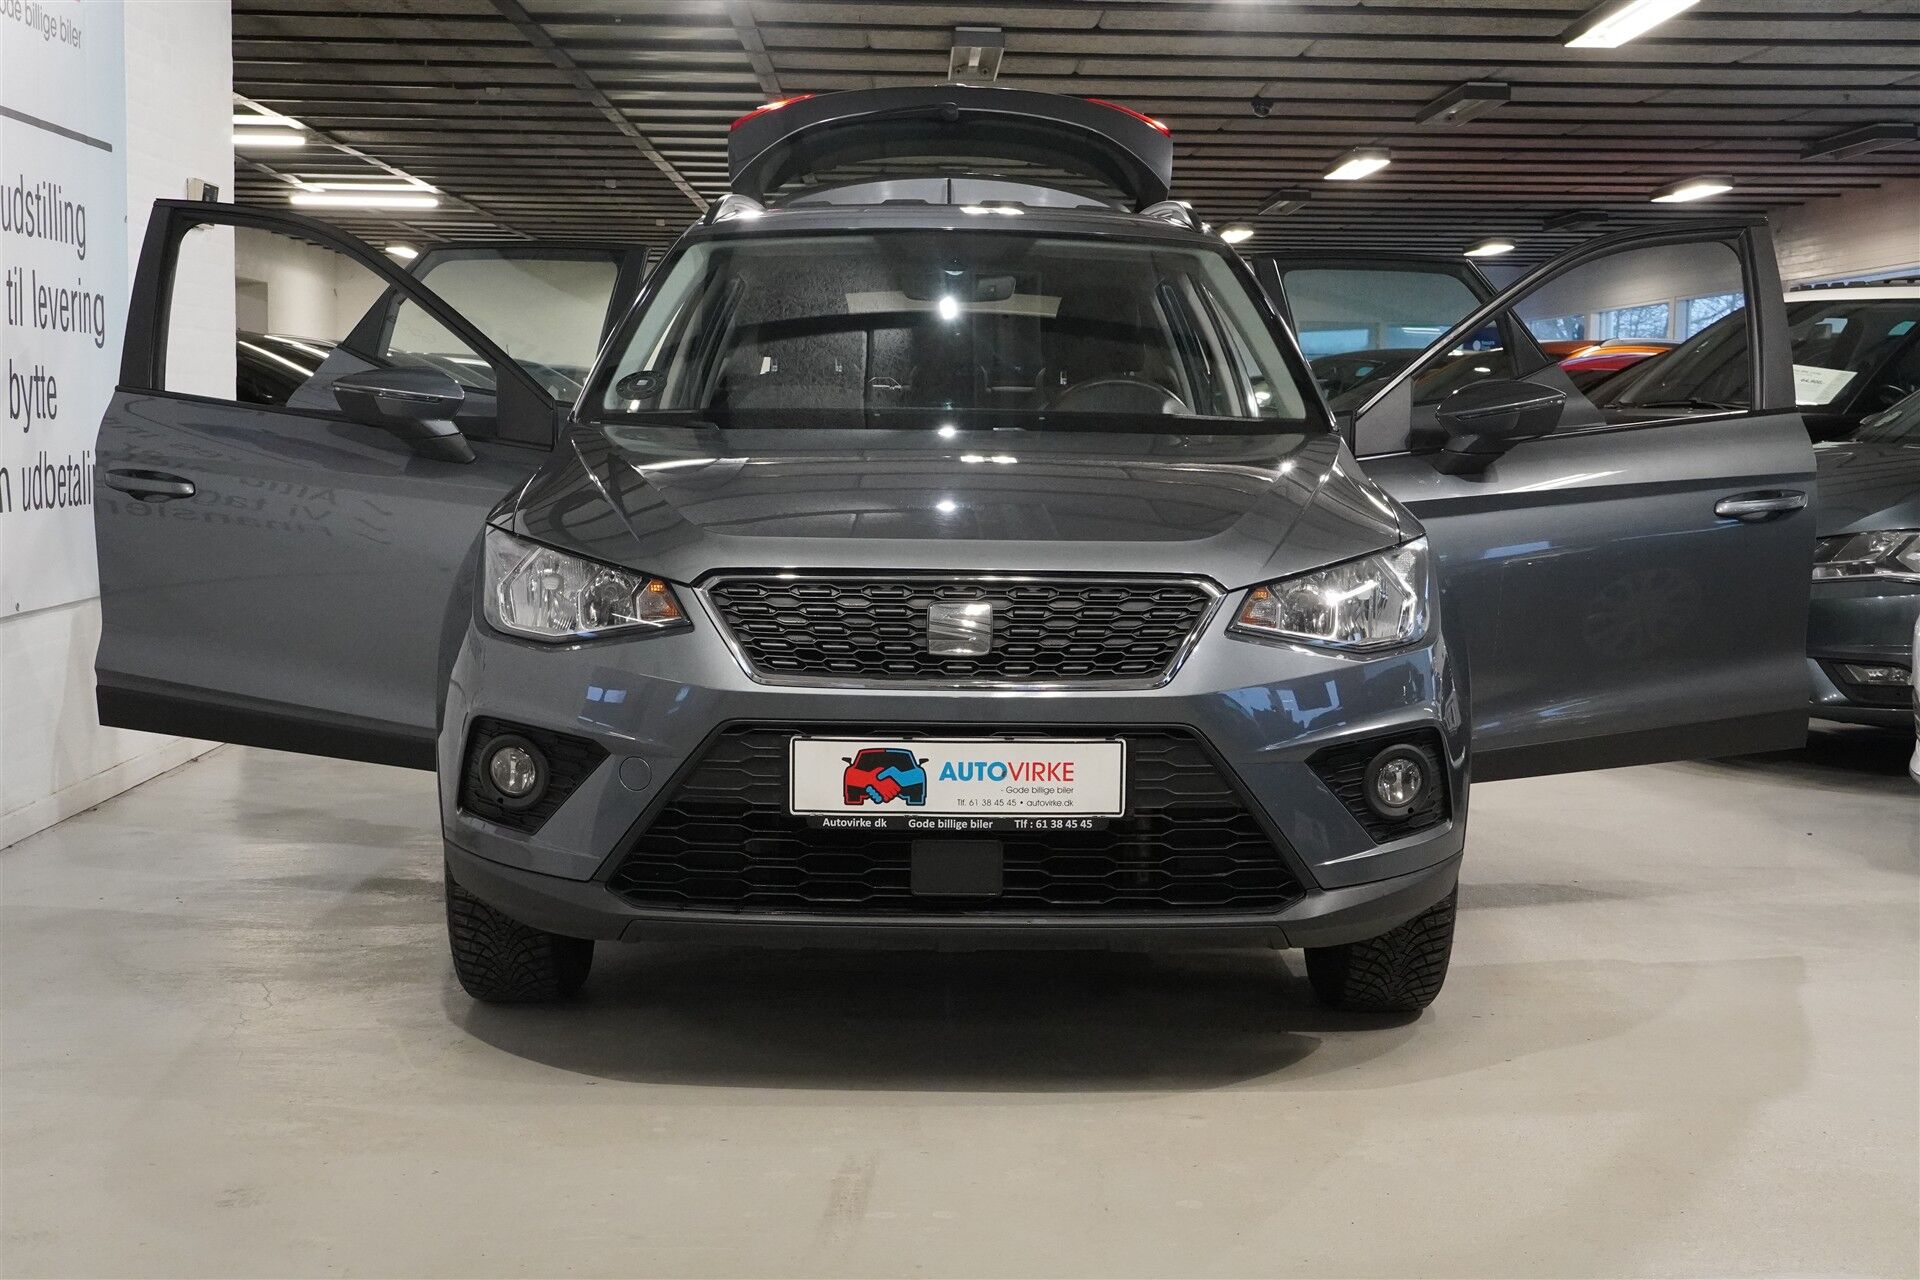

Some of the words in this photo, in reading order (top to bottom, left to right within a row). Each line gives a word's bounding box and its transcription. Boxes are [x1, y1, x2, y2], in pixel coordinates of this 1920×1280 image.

[25, 0, 57, 41] billige
[60, 16, 81, 48] biler
[1, 174, 86, 260] udstilling
[6, 266, 23, 326] til
[32, 269, 105, 349] levering
[9, 358, 57, 433] bytte
[22, 450, 95, 512] udbetali
[939, 761, 1075, 782] AUTOVIRKE
[1005, 786, 1030, 794] Gode
[1031, 786, 1055, 796] billige
[1057, 786, 1074, 794] biler
[822, 818, 872, 828] Autovirke
[874, 818, 887, 828] dk
[908, 819, 935, 829] Gode
[938, 819, 968, 830] billige
[970, 819, 993, 829] biler
[1014, 819, 1028, 829] Tlf
[1035, 819, 1048, 829] 61
[1050, 819, 1063, 829] 38
[1065, 819, 1078, 829] 45
[1080, 819, 1093, 829] 45
[969, 798, 979, 807] 61
[982, 798, 992, 807] 38
[994, 798, 1004, 807] 45
[1006, 798, 1017, 807] 45
[1026, 798, 1074, 807] autovirke.dk
